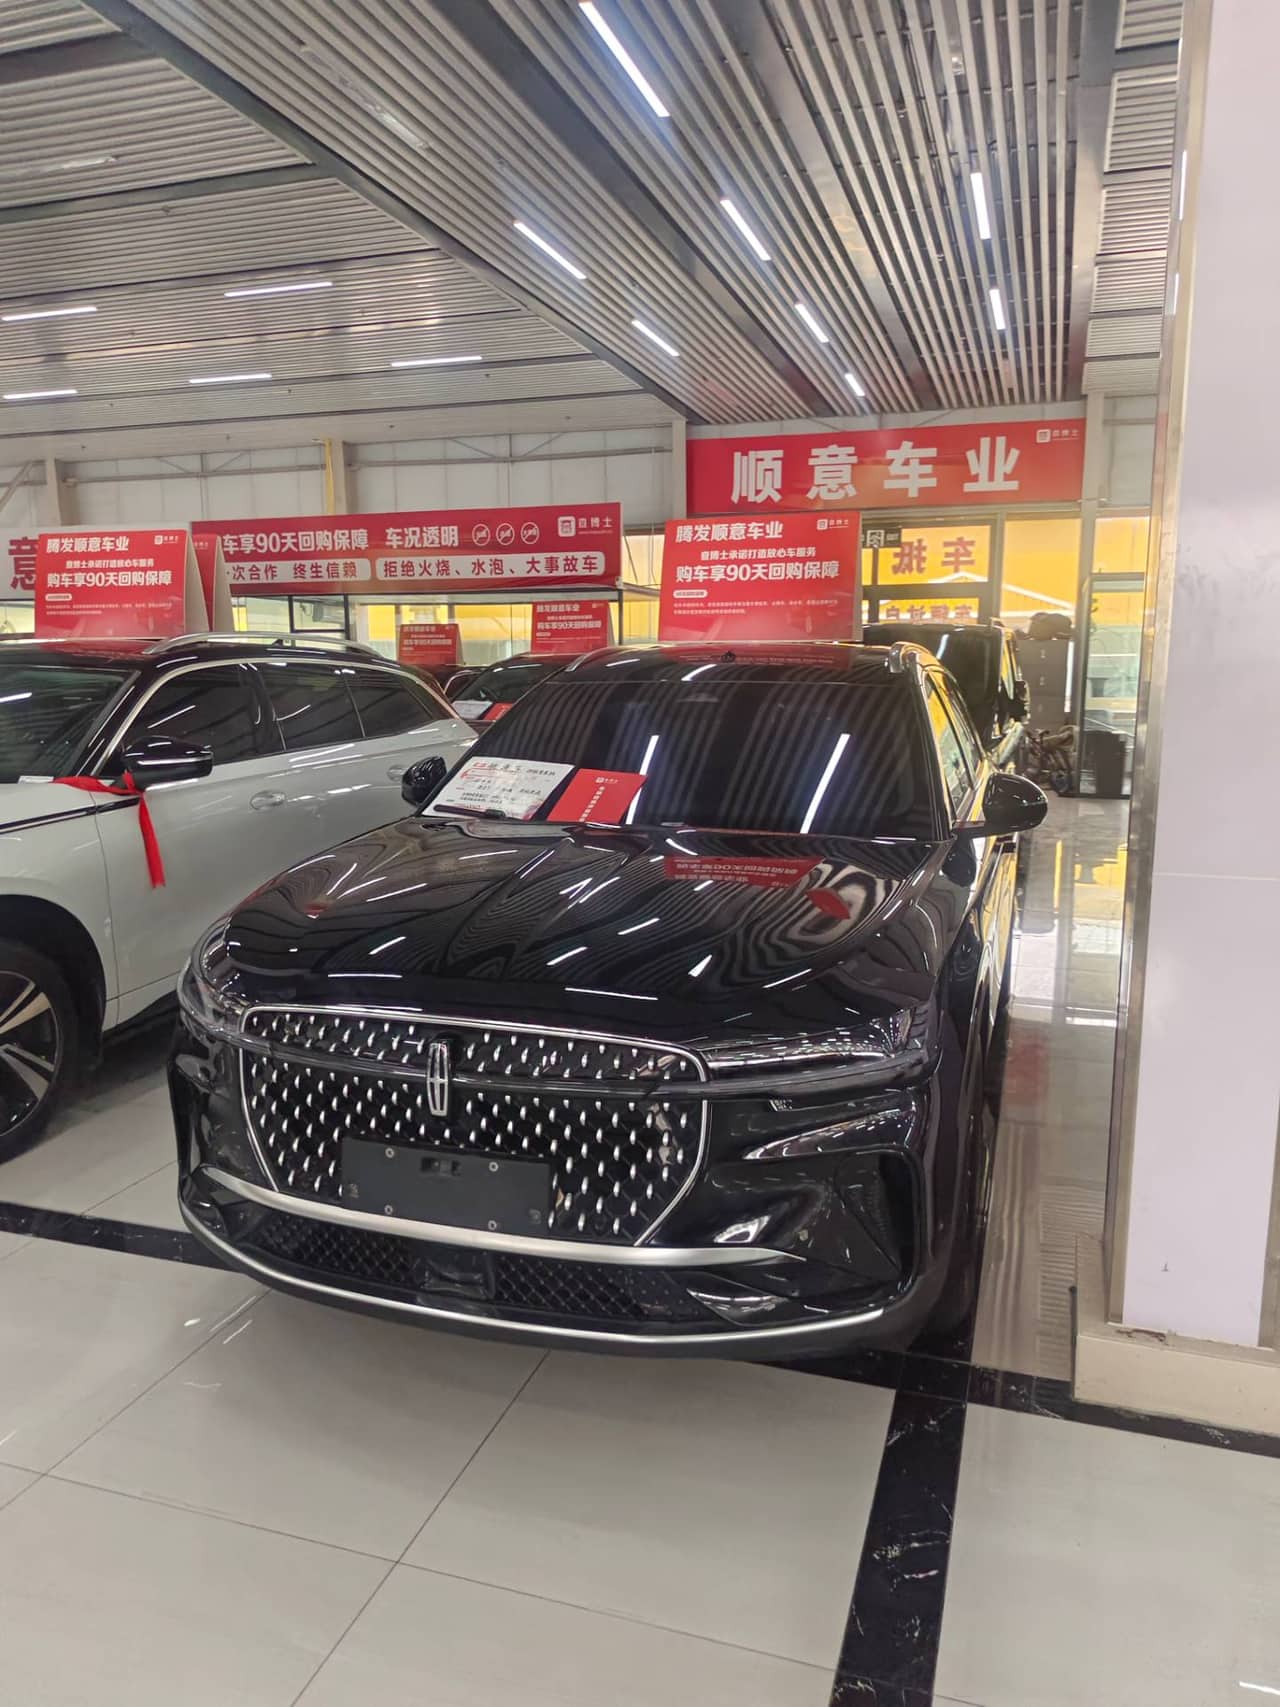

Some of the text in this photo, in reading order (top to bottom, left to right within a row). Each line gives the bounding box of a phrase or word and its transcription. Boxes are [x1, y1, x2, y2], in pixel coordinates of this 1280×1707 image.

[731, 436, 1020, 504] 顺意车业
[385, 525, 459, 548] 车况透明
[675, 521, 783, 543] 腾发顺意车业
[46, 535, 130, 553] 腾发顺意车业
[226, 562, 358, 581] 次合作 终生信赖
[383, 556, 599, 578] 拒绝火烧、水泡、大事故车
[675, 560, 840, 583] 购车享90天回购保障
[47, 570, 172, 588] 购车享90天回购保障
